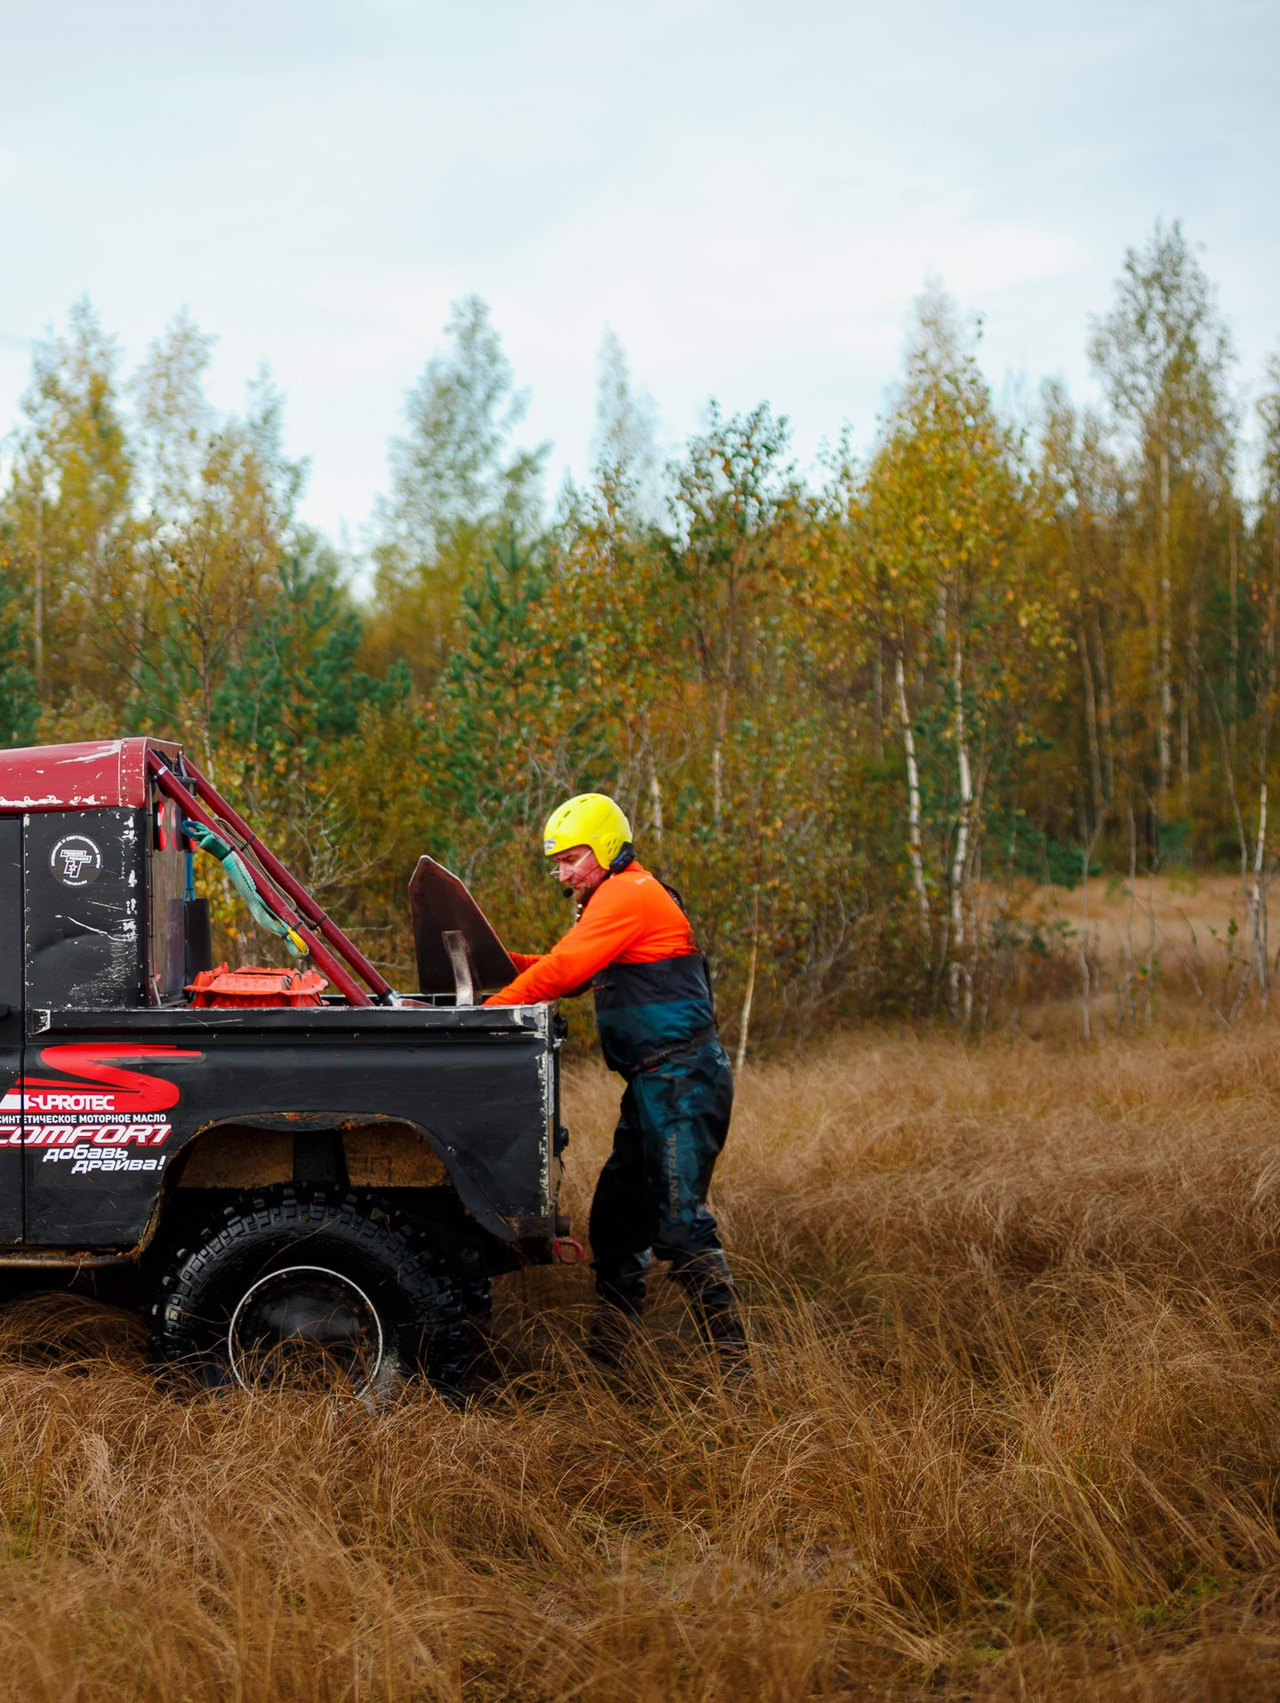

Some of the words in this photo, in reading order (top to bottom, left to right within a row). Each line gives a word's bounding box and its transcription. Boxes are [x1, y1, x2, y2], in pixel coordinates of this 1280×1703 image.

[78, 1114, 131, 1124] МОТОРНОЕ
[132, 1113, 167, 1123] МАСЛО
[43, 1144, 128, 1162] добавь
